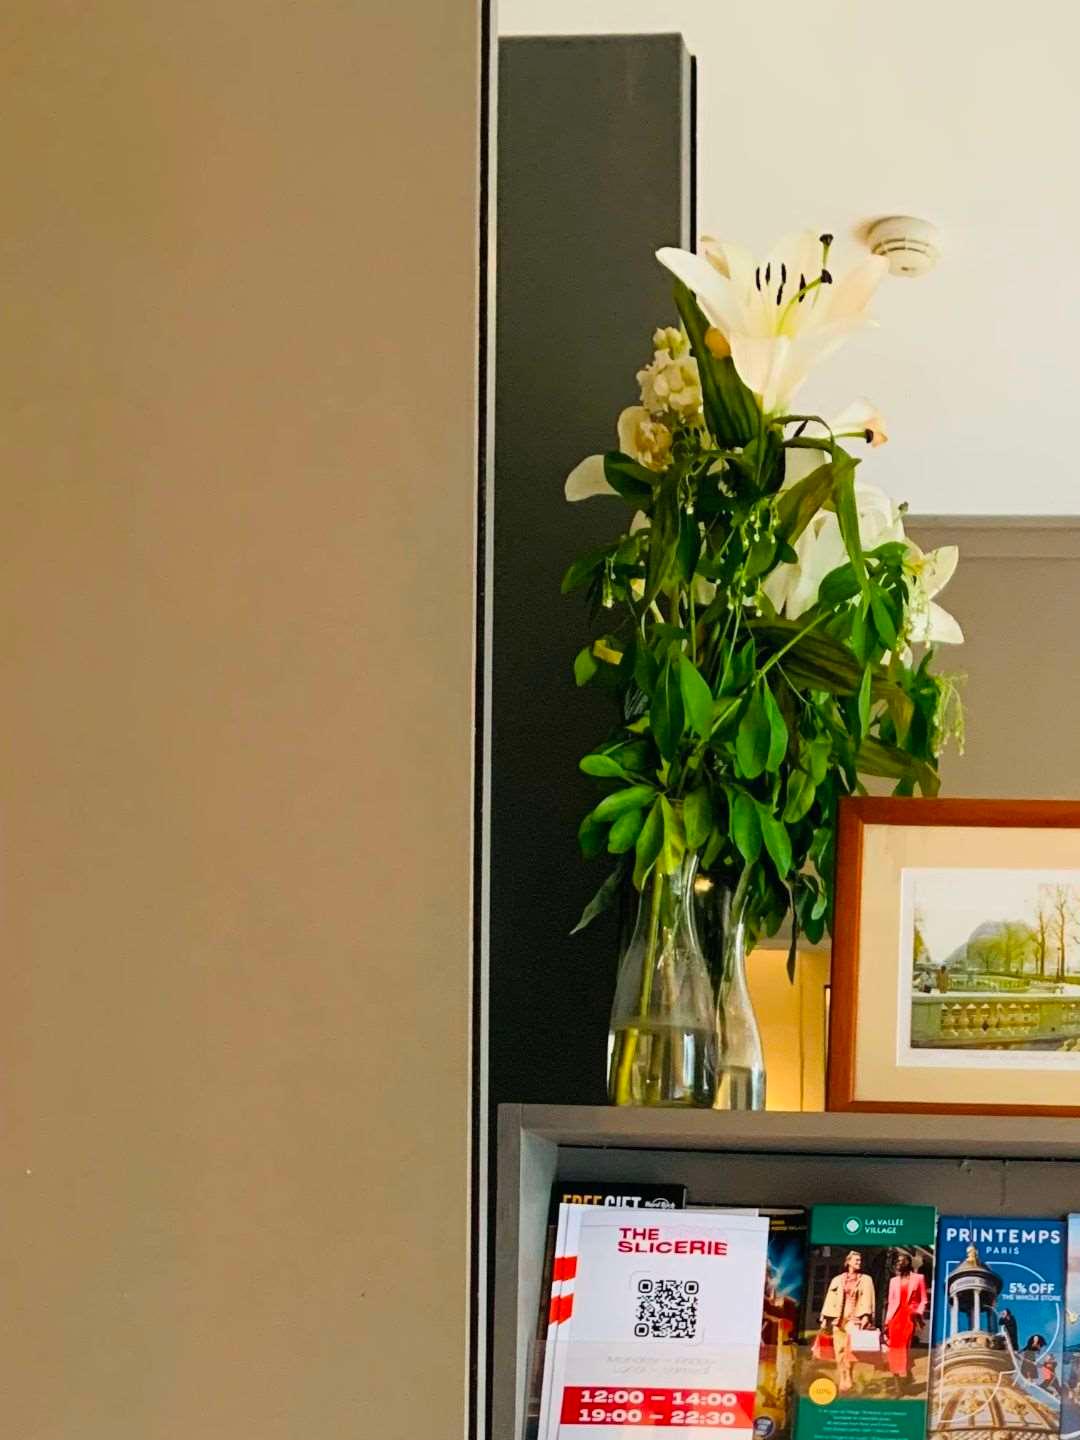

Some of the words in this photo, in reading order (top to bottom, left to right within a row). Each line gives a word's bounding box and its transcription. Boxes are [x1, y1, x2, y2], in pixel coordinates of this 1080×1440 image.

[864, 1218, 876, 1226] LA
[877, 1217, 904, 1227] VALLÉE
[619, 1228, 660, 1240] THE
[865, 1226, 898, 1234] VILLAGE
[946, 1227, 1061, 1244] PRINTEMPS
[617, 1241, 728, 1256] SLICERIE
[985, 1246, 1020, 1255] PARIS
[1009, 1282, 1027, 1294] 5%
[1028, 1283, 1055, 1294] OFF
[581, 1389, 645, 1404] 12:00
[672, 1391, 738, 1407] 14:00
[578, 1408, 643, 1423] 19:00
[670, 1410, 736, 1425] 22:30
